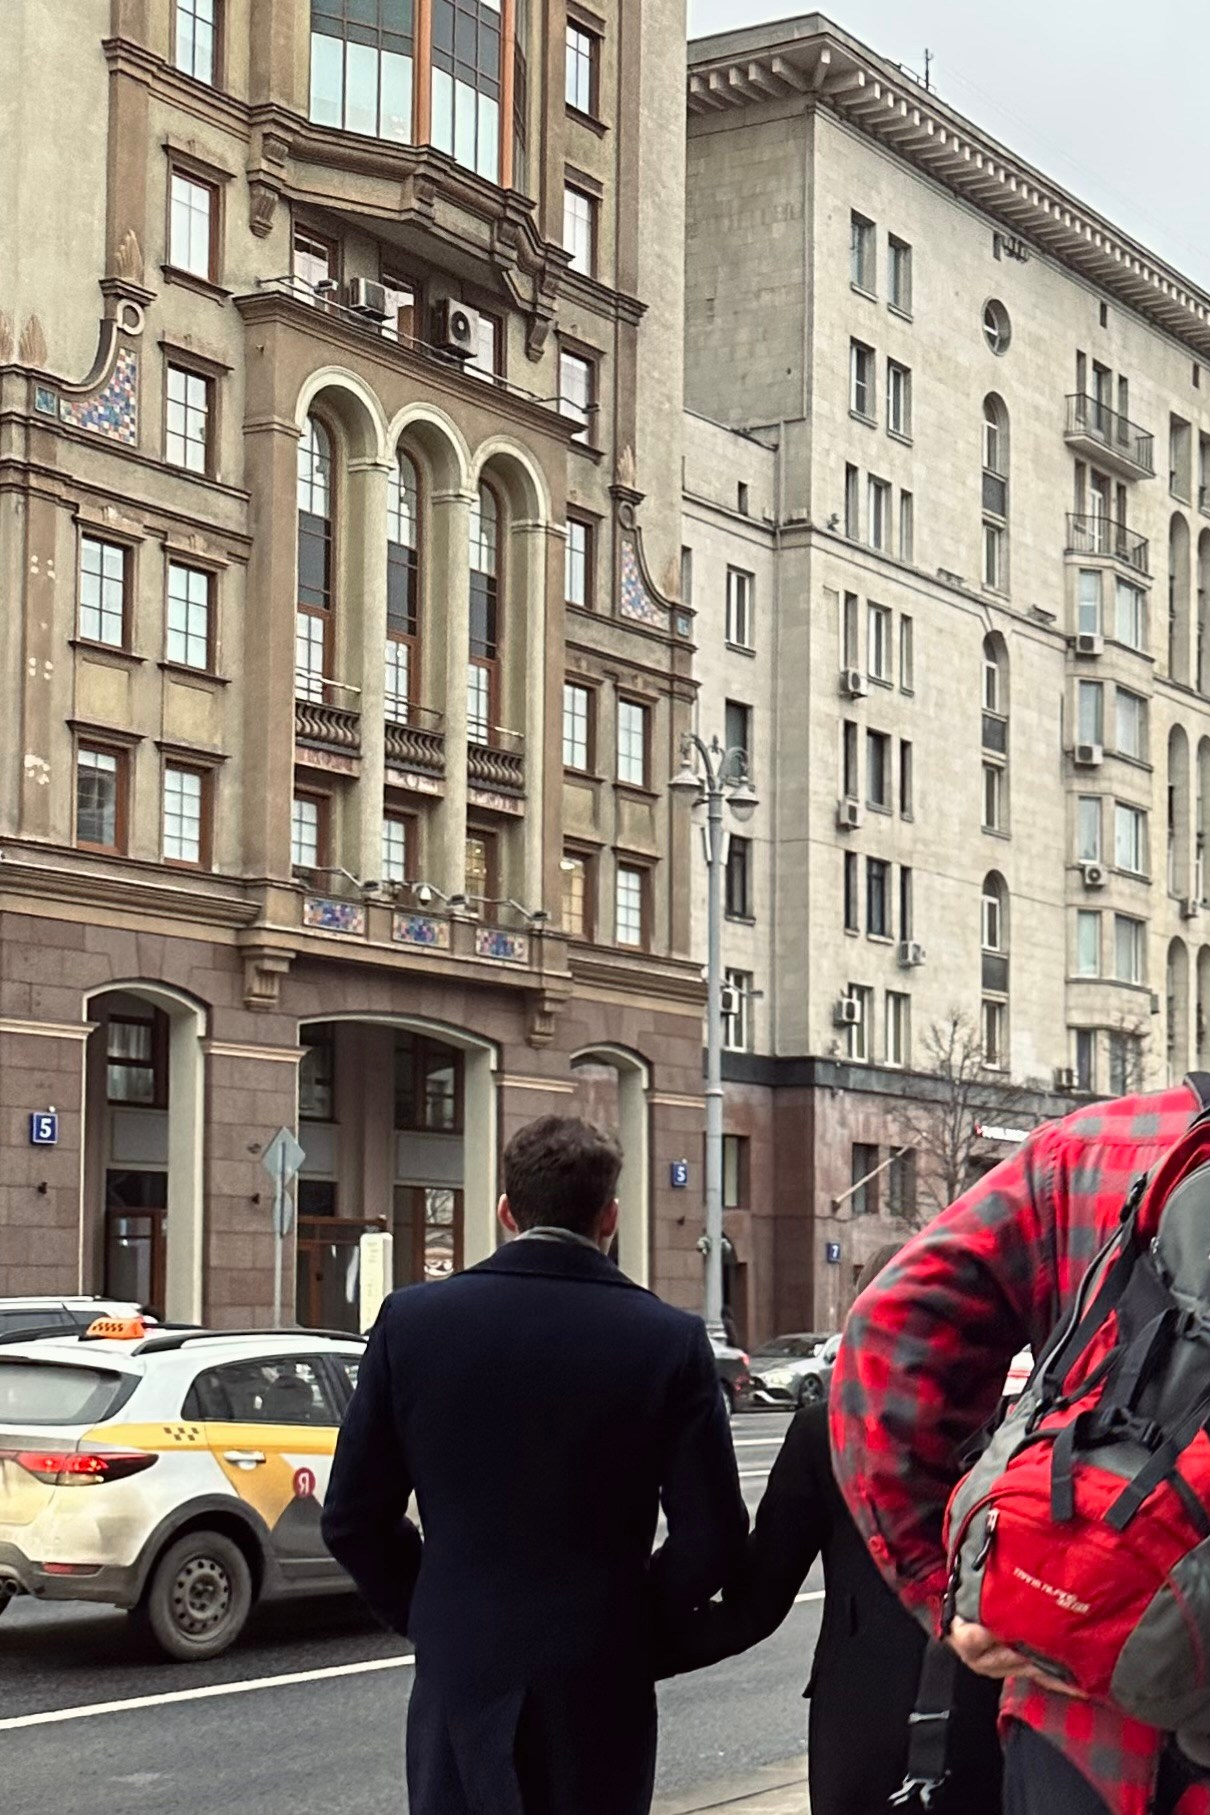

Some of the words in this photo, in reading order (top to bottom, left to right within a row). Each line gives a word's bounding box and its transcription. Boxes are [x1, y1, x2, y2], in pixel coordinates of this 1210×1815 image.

[39, 1117, 52, 1139] 5
[677, 1165, 686, 1182] 5
[831, 1244, 839, 1258] 7
[298, 1472, 310, 1495] Я
